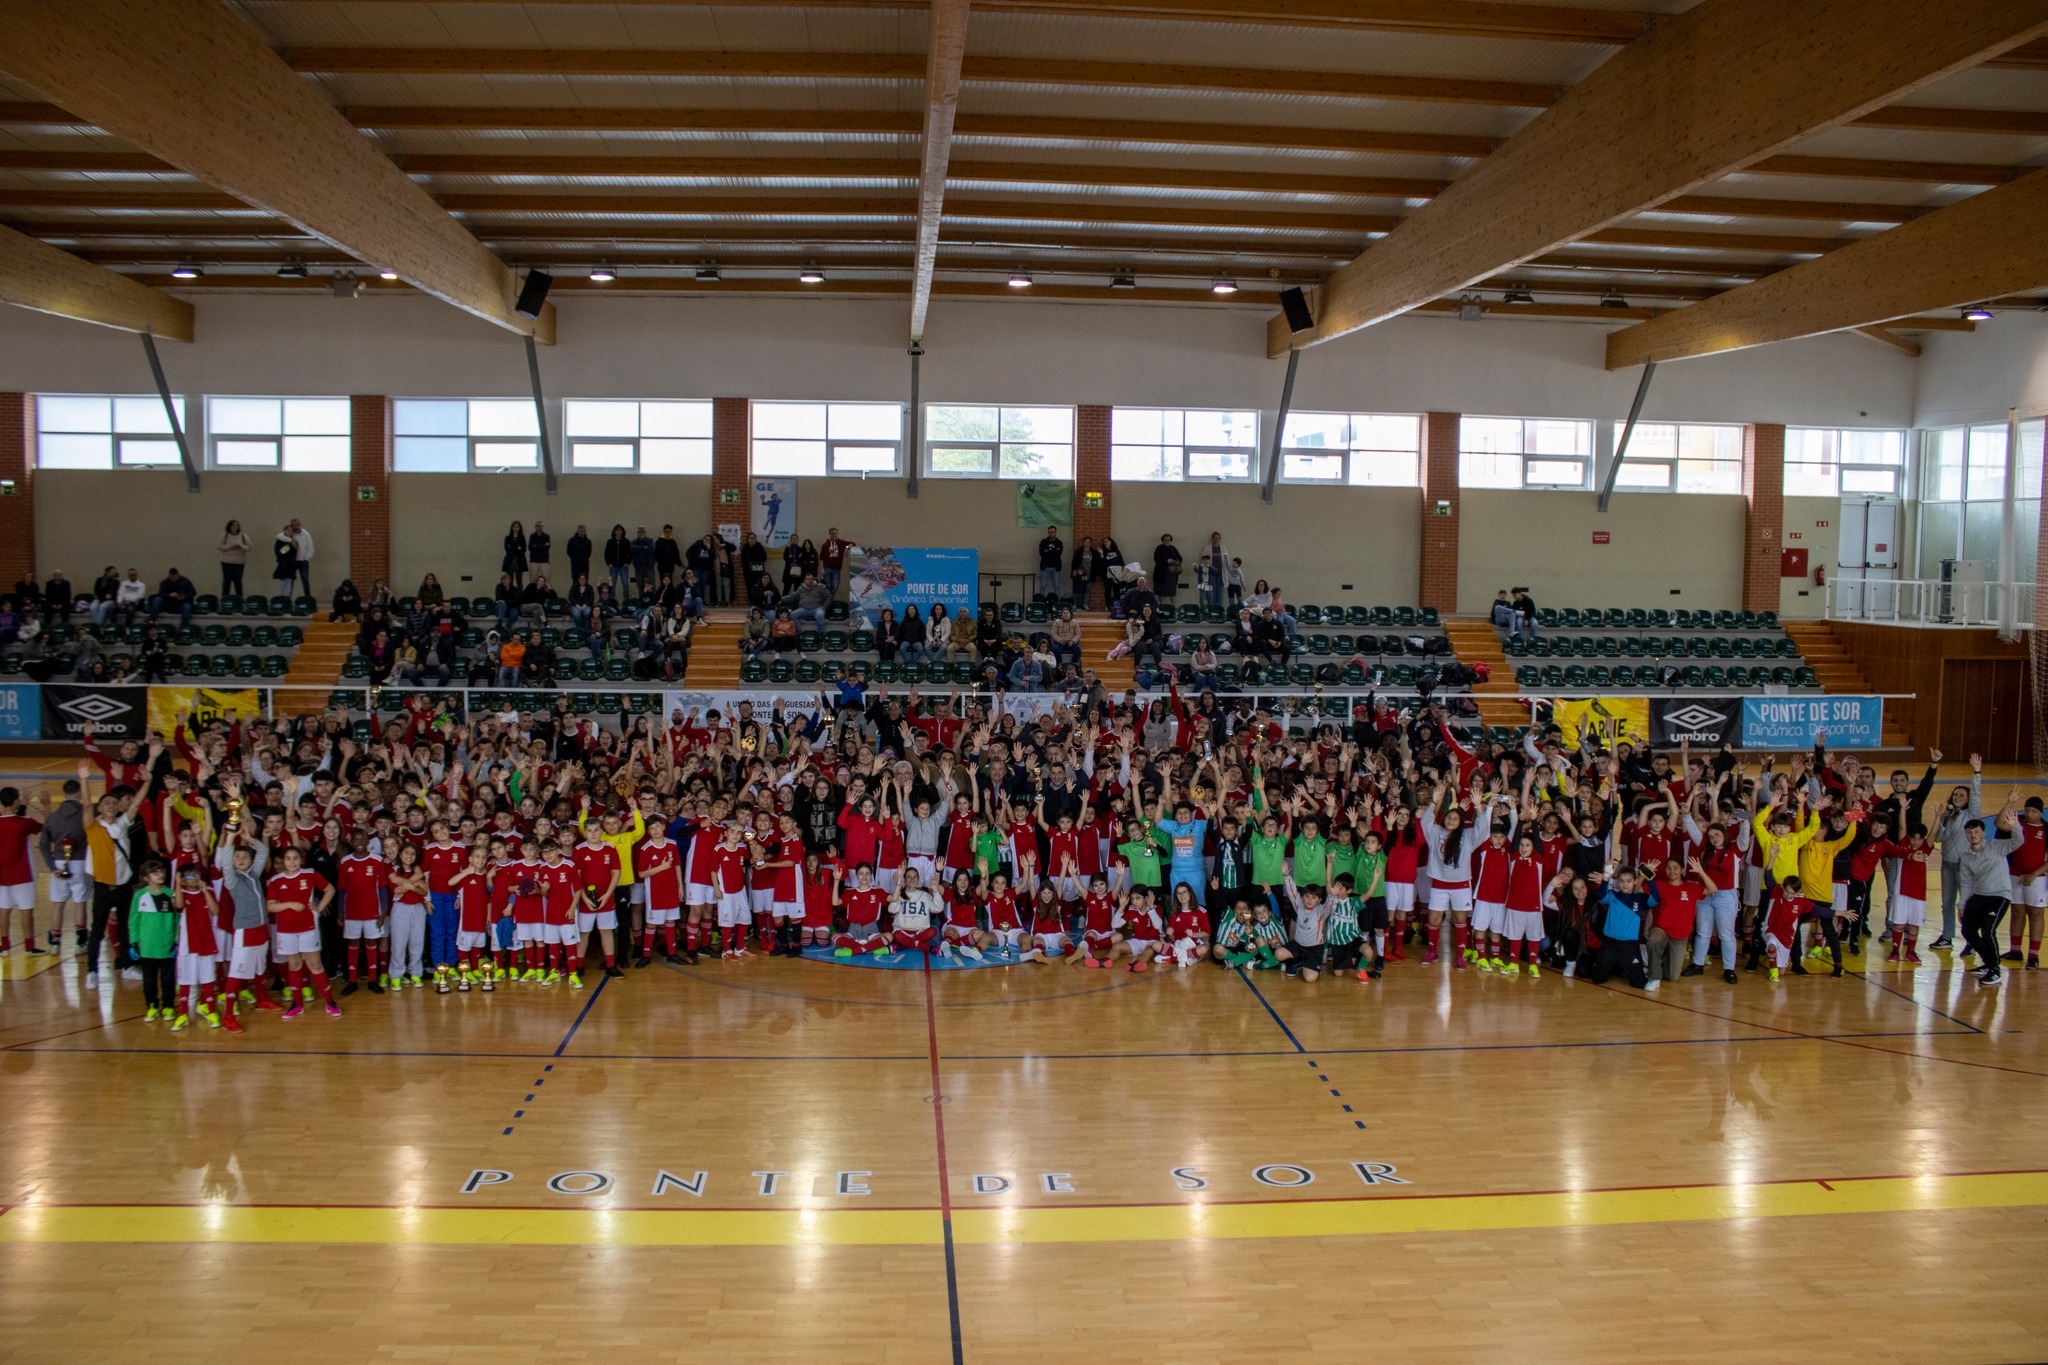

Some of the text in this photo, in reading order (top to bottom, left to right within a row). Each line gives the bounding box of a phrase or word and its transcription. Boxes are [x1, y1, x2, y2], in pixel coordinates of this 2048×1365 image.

[908, 583, 968, 594] PONTE DE SOR
[930, 595, 968, 604] Desportiva
[1760, 702, 1860, 722] PONTE DE SOR
[1750, 722, 1870, 736] Dinâmica Desportiva
[1670, 731, 1720, 742] umbro
[901, 901, 927, 916] USA
[460, 1161, 1414, 1197] PONTE DE SOR
